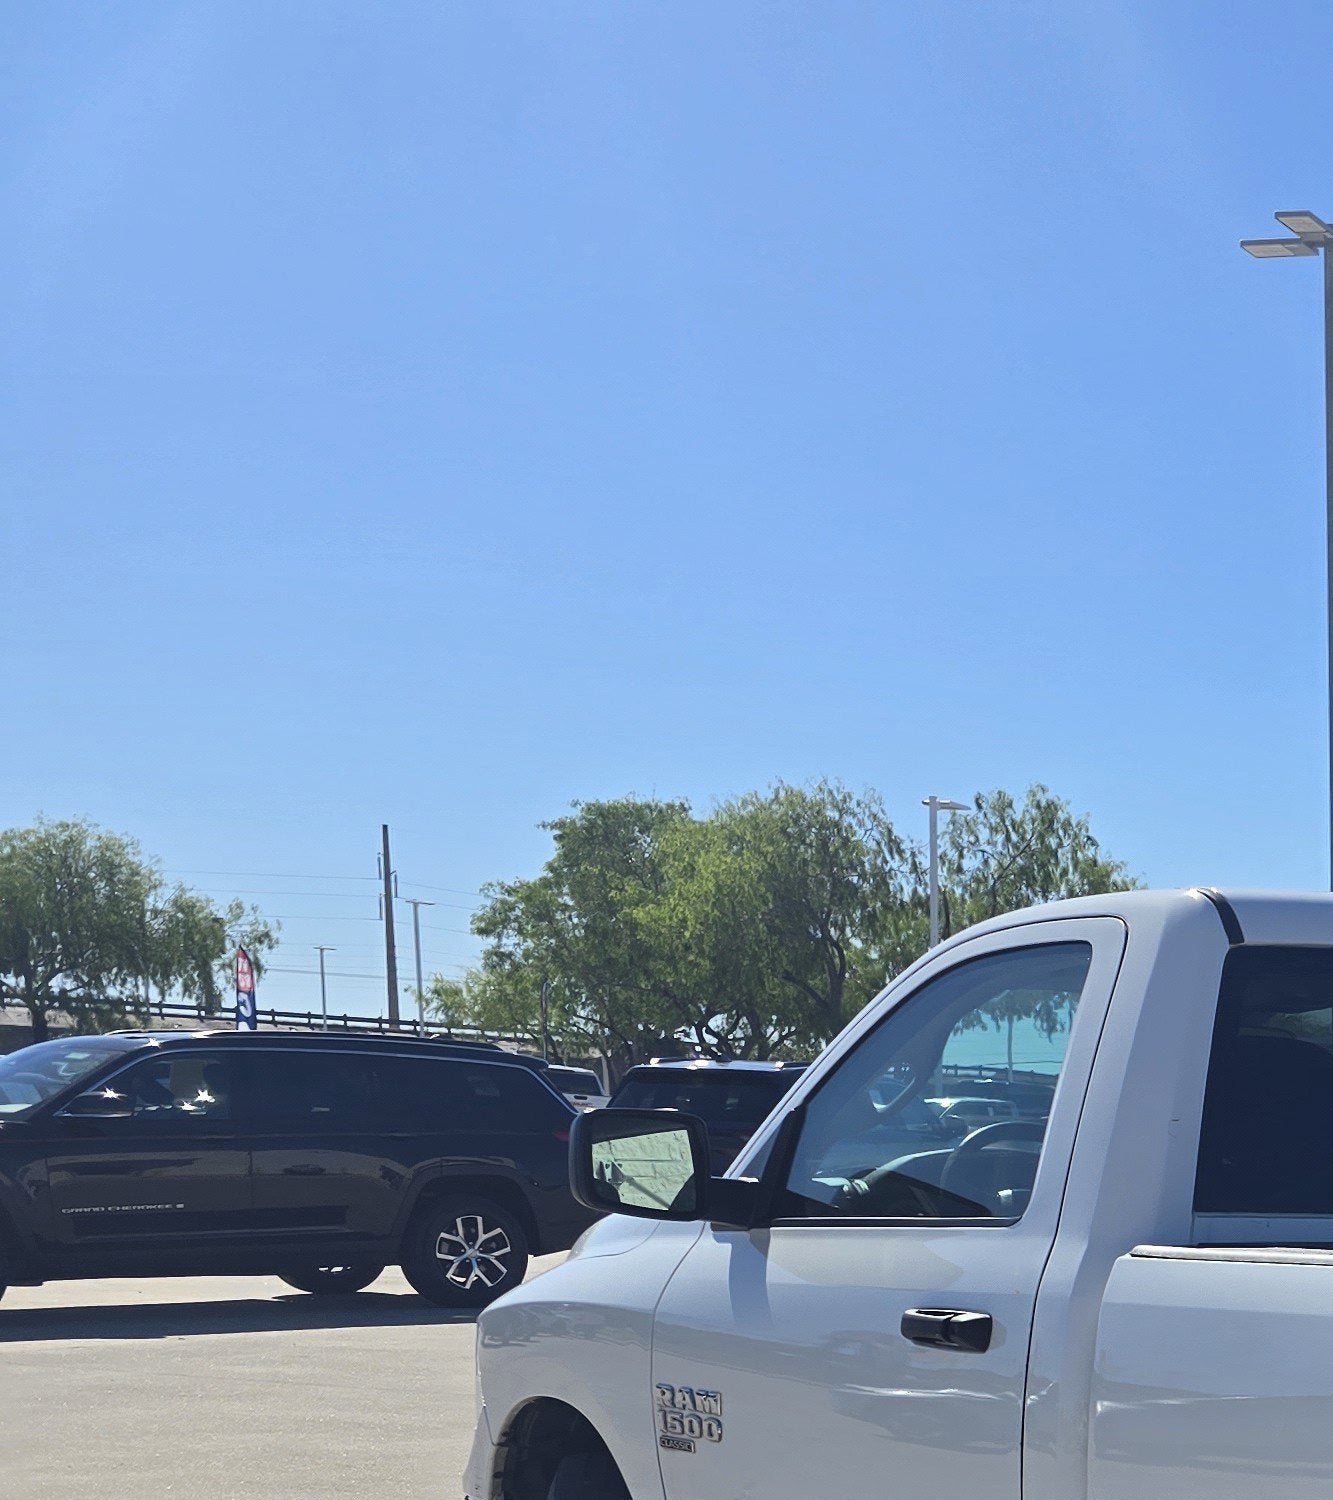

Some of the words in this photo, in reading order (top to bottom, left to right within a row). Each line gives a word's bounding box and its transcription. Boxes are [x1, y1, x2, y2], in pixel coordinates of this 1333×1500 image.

[61, 1206, 105, 1214] GRAND
[108, 1203, 172, 1211] CHEROKEE
[656, 1382, 722, 1416] RAM
[657, 1409, 722, 1443] 1500
[660, 1436, 694, 1452] CLASSIC
